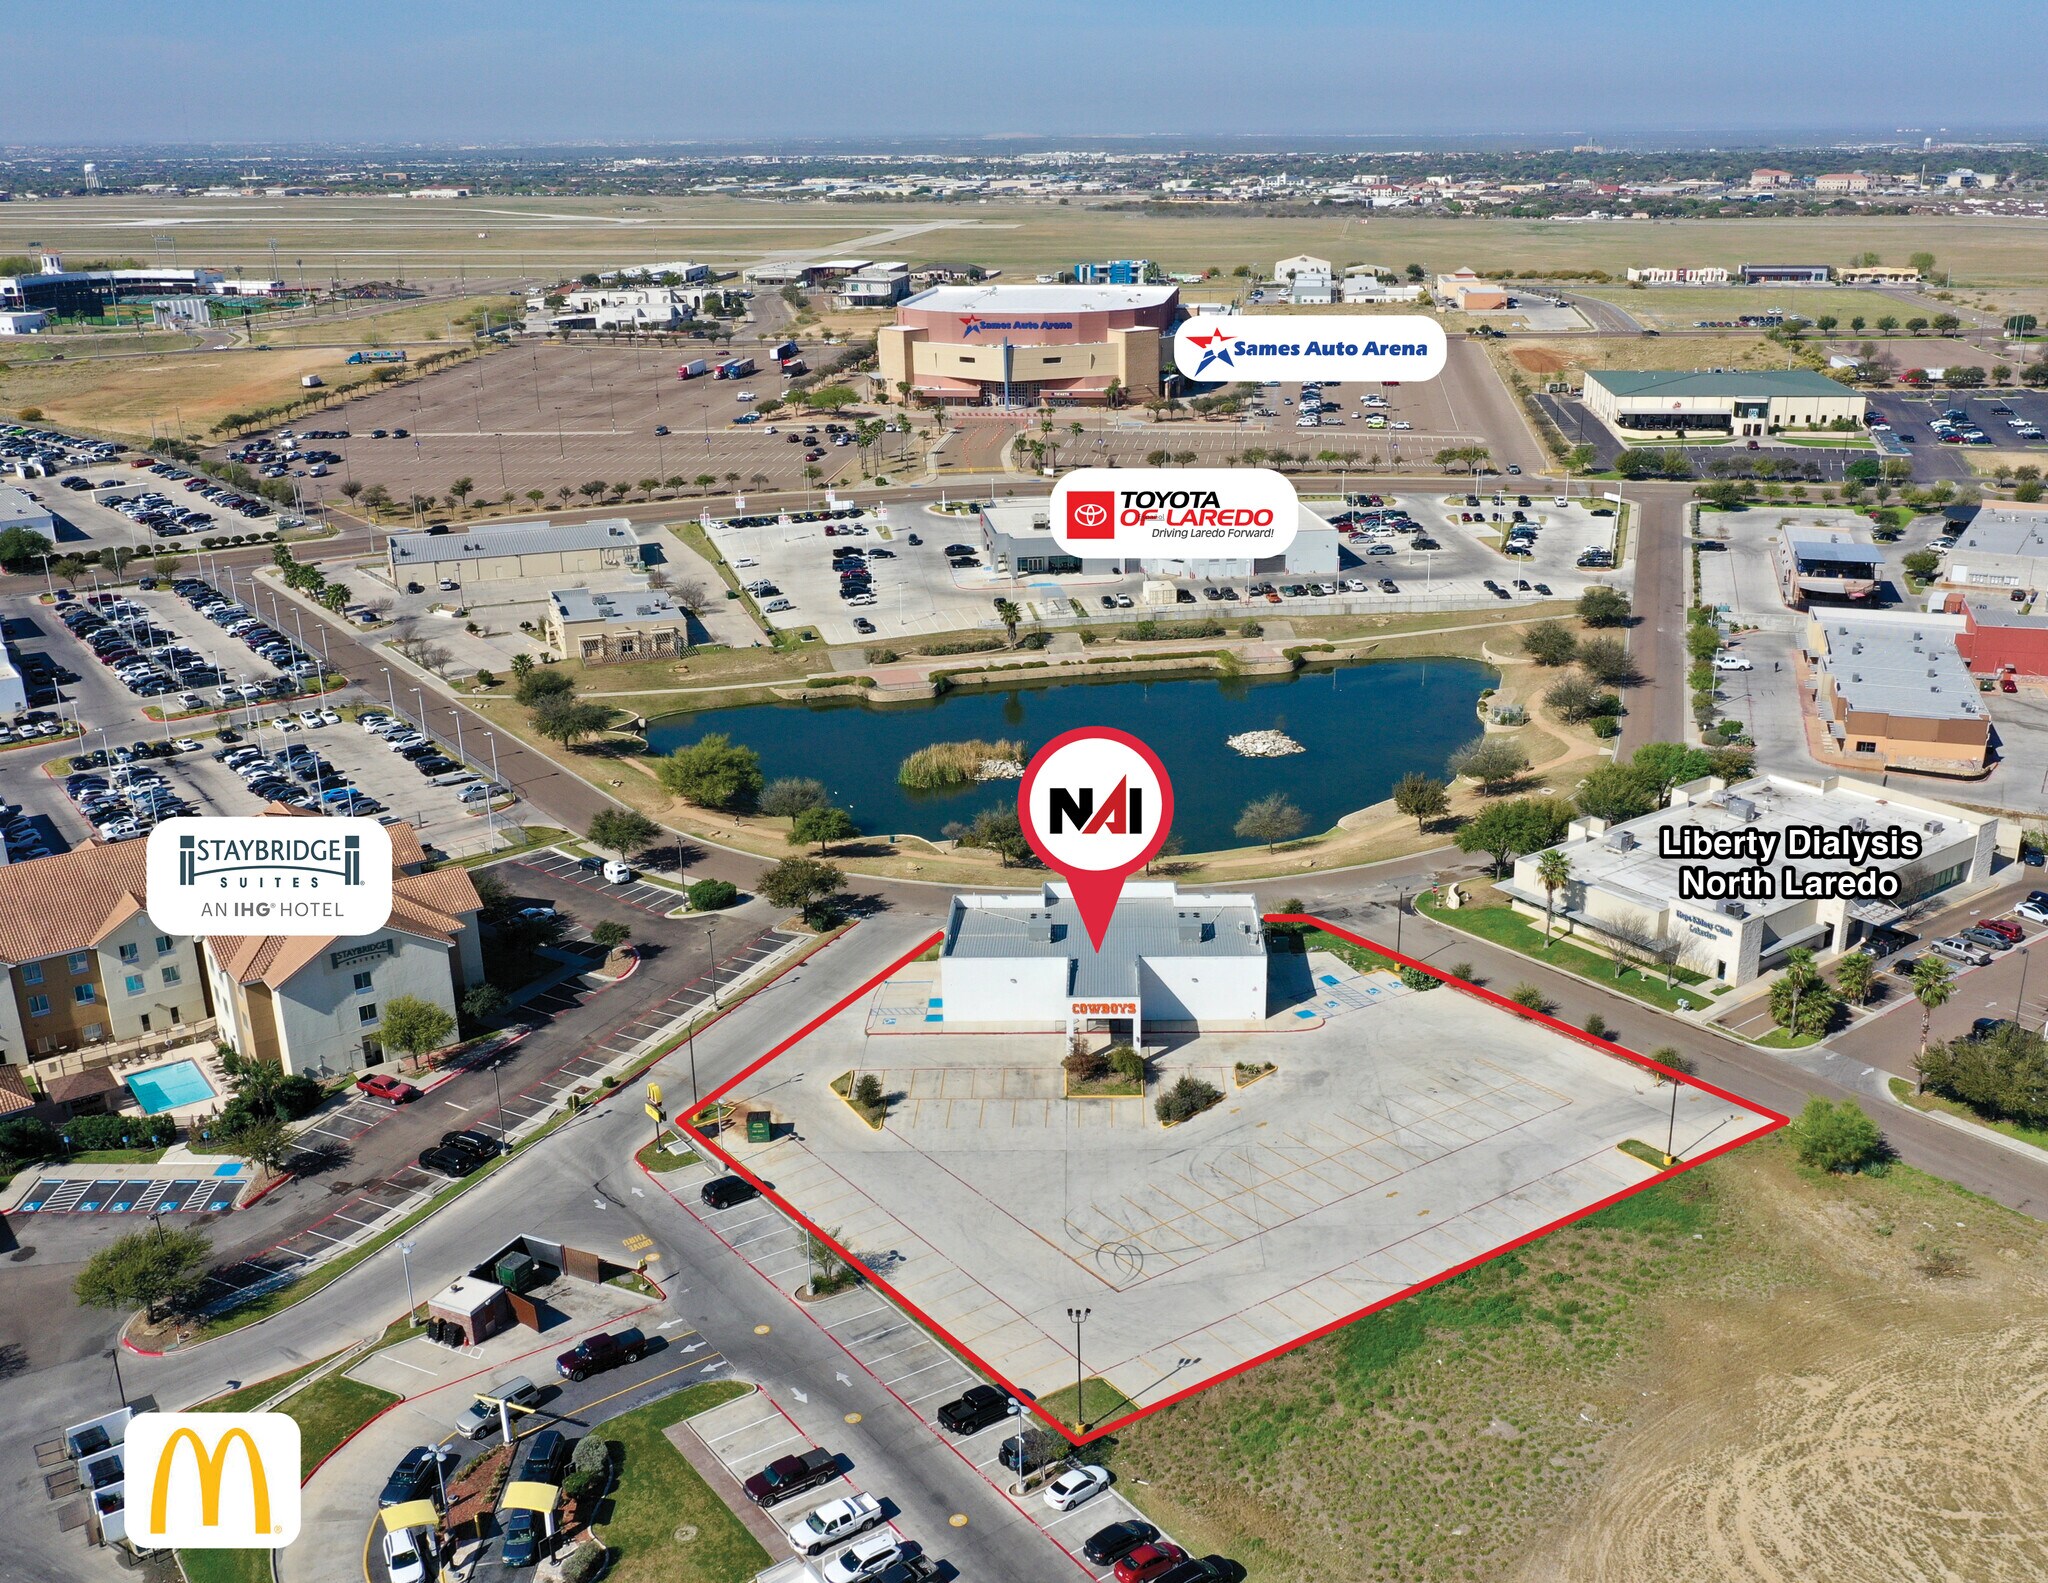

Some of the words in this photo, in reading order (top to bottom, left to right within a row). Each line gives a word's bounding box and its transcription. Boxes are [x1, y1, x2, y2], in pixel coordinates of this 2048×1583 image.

[980, 321, 1011, 330] Sames
[1013, 321, 1039, 330] Auto
[1040, 321, 1072, 330] Arena
[337, 940, 387, 960] STAYBRIDGE
[1072, 1003, 1136, 1015] COWBOYS
